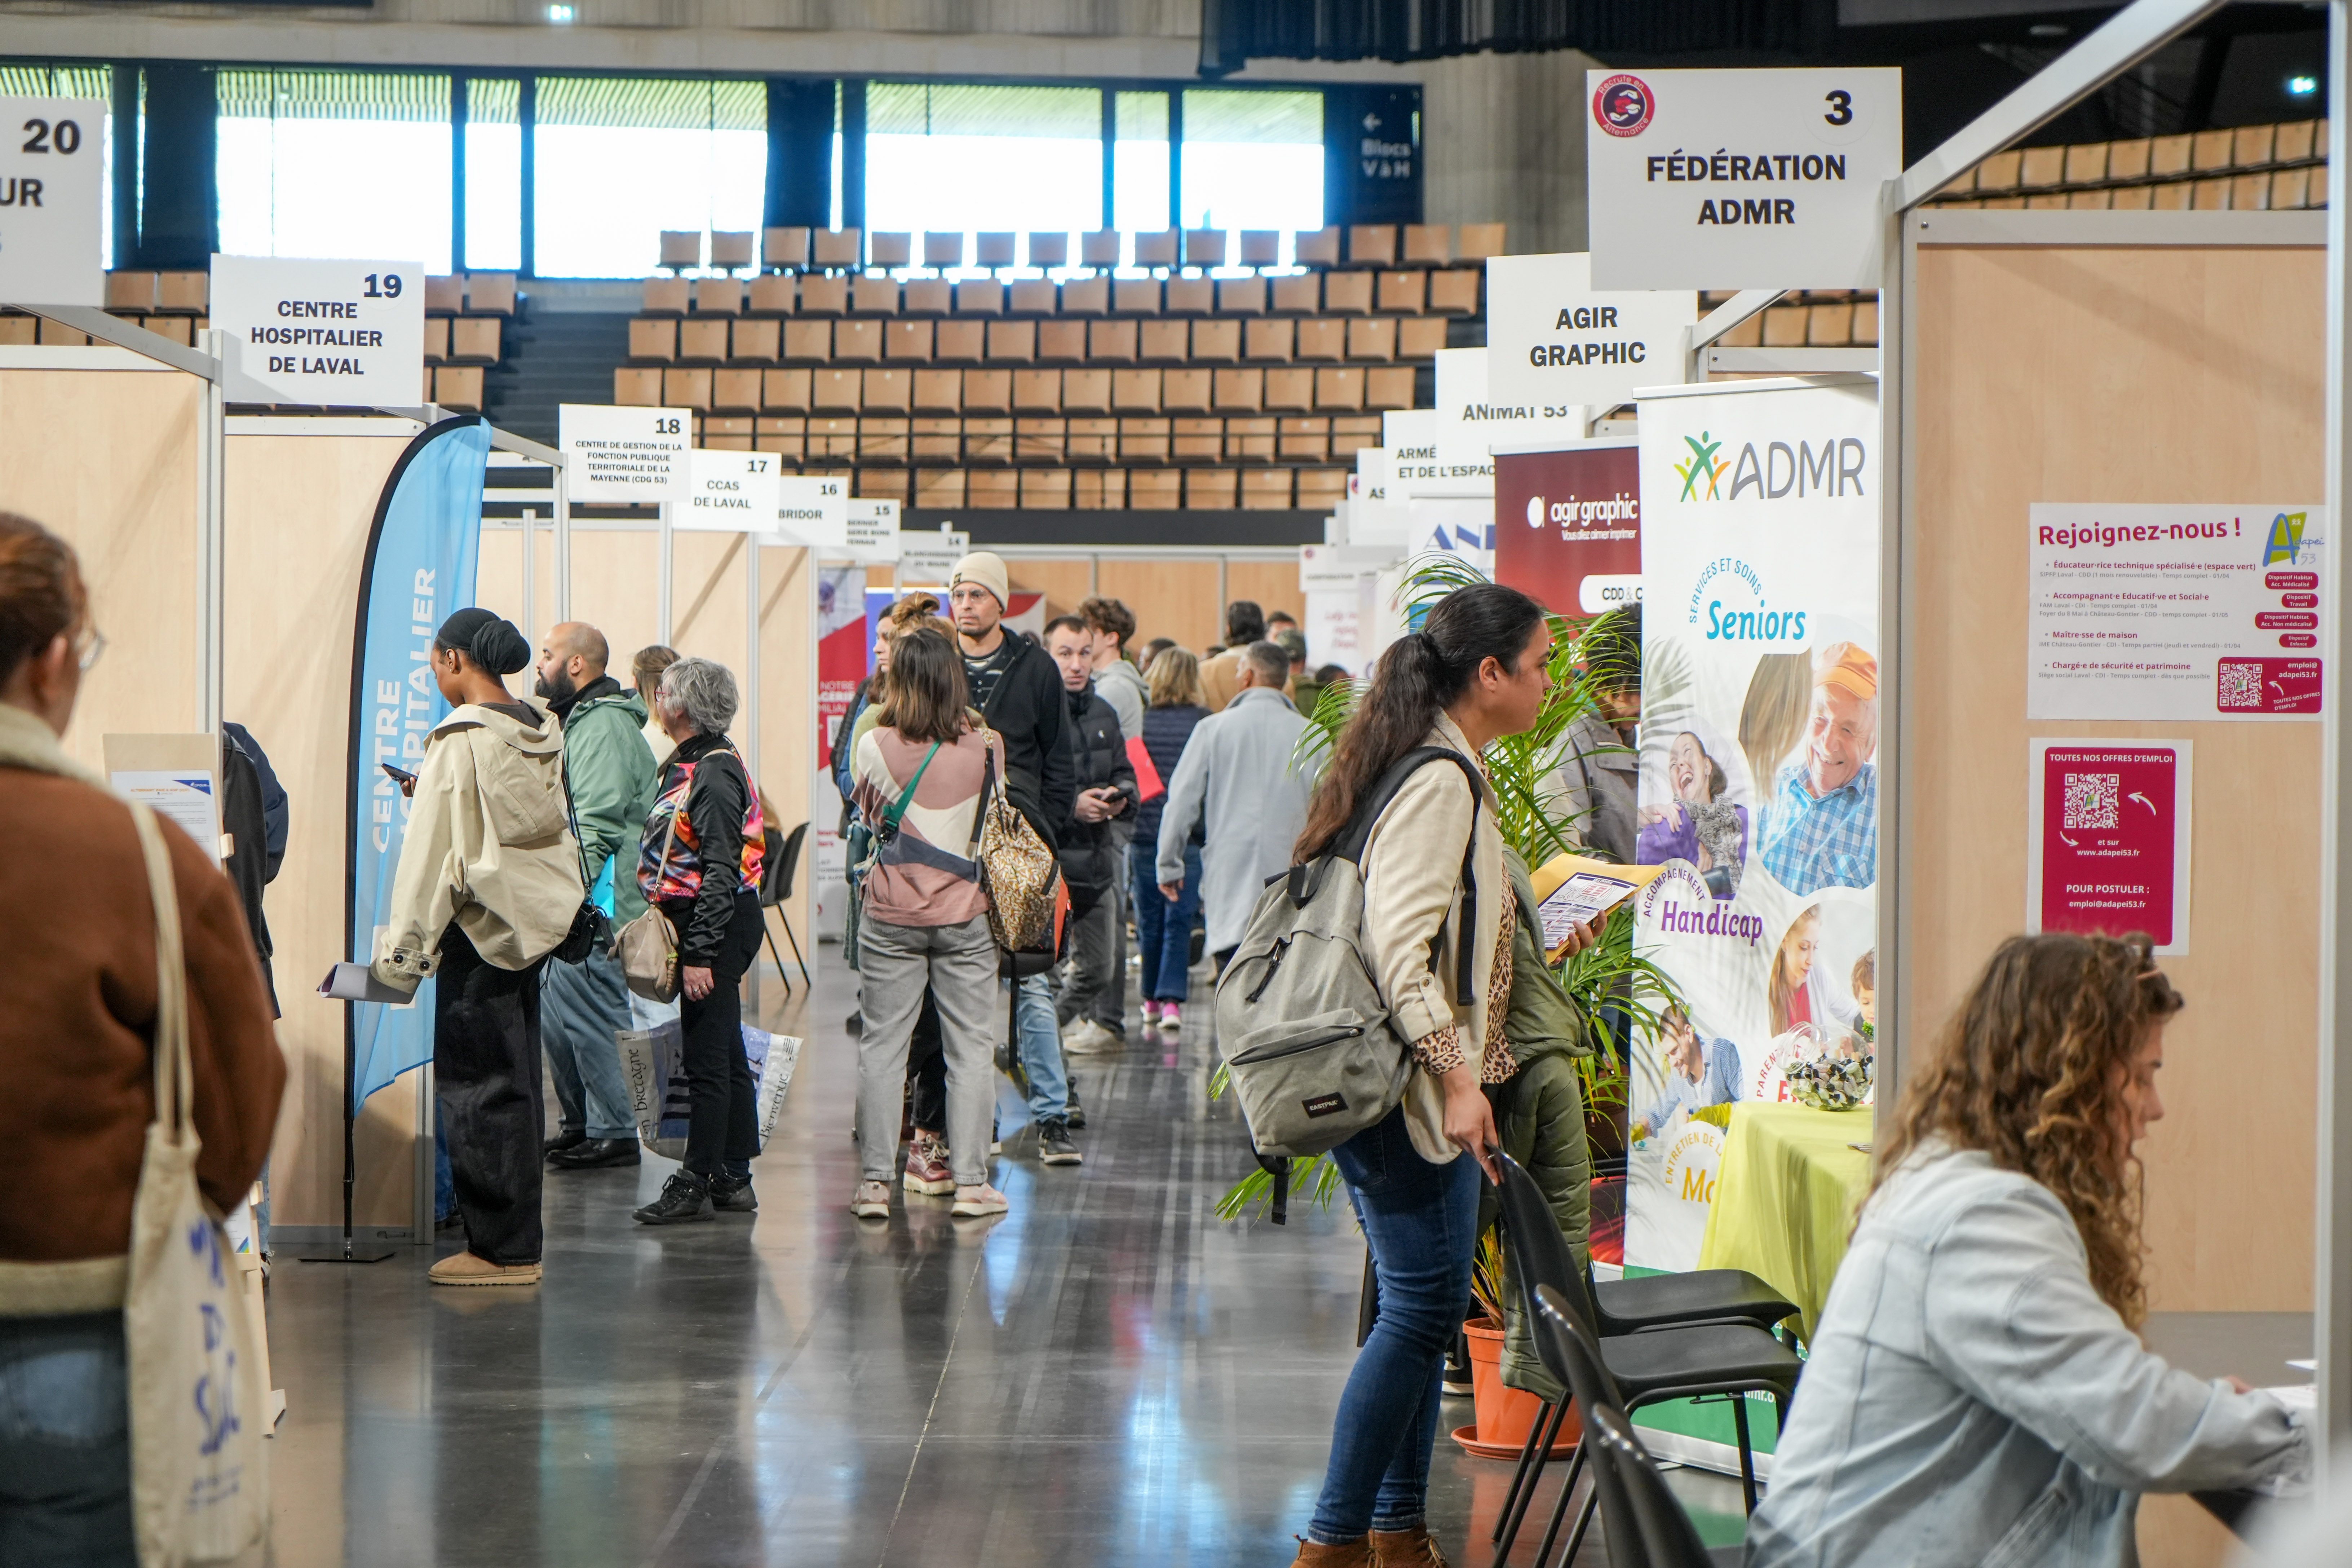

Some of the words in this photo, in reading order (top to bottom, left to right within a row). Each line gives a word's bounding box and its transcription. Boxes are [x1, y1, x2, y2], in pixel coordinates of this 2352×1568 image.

[1598, 75, 1632, 94] Recrute
[1634, 80, 1644, 89] en
[1824, 90, 1853, 125] 3
[22, 119, 81, 155] 20
[1603, 118, 1648, 136] Alternance
[1647, 148, 1845, 181] FÉDÉRATION
[1697, 199, 1795, 224] ADMR
[363, 274, 402, 298] 19
[277, 301, 357, 319] CENTRE
[1556, 306, 1618, 330] AGIR
[251, 327, 383, 347] HOSPITALIER
[1530, 341, 1645, 367] GRAPHIC
[269, 356, 296, 372] DE
[302, 357, 364, 376] LAVAL
[655, 418, 680, 434] 18
[1397, 445, 1436, 459] ARMÉ
[748, 460, 768, 472] 17
[1400, 467, 1413, 478] ET
[1419, 467, 1436, 477] DE
[1730, 438, 1865, 500] ADMR
[707, 480, 739, 490] CCAS
[821, 484, 837, 495] 16
[694, 497, 709, 507] DE
[715, 498, 751, 508] LAVAL
[875, 505, 890, 515] 15
[778, 509, 822, 519] BRIDOR
[2039, 521, 2227, 548] Rejoignez-nous
[2235, 517, 2241, 536] !
[2114, 562, 2154, 570] technique
[2301, 553, 2316, 565] 53
[1602, 588, 1624, 600] CDD
[1689, 562, 1717, 623] SERVICES
[1720, 558, 1731, 571] ET
[1734, 560, 1761, 595] SOINS
[1707, 600, 1806, 640] Seniors
[372, 680, 400, 853] CENTRE
[1644, 868, 1705, 917] ACCOMPAGNEMENT
[2069, 900, 2146, 909] emploi@adapei53.fr
[1661, 901, 1763, 946] Handicap
[629, 1048, 648, 1111] Bretagne
[760, 1073, 788, 1138] Bienvenue
[1309, 1100, 1338, 1110] EASTPAK
[1666, 1132, 1699, 1184] ENTRETIEN
[1703, 1133, 1715, 1147] DE
[1715, 1143, 1721, 1156] L
